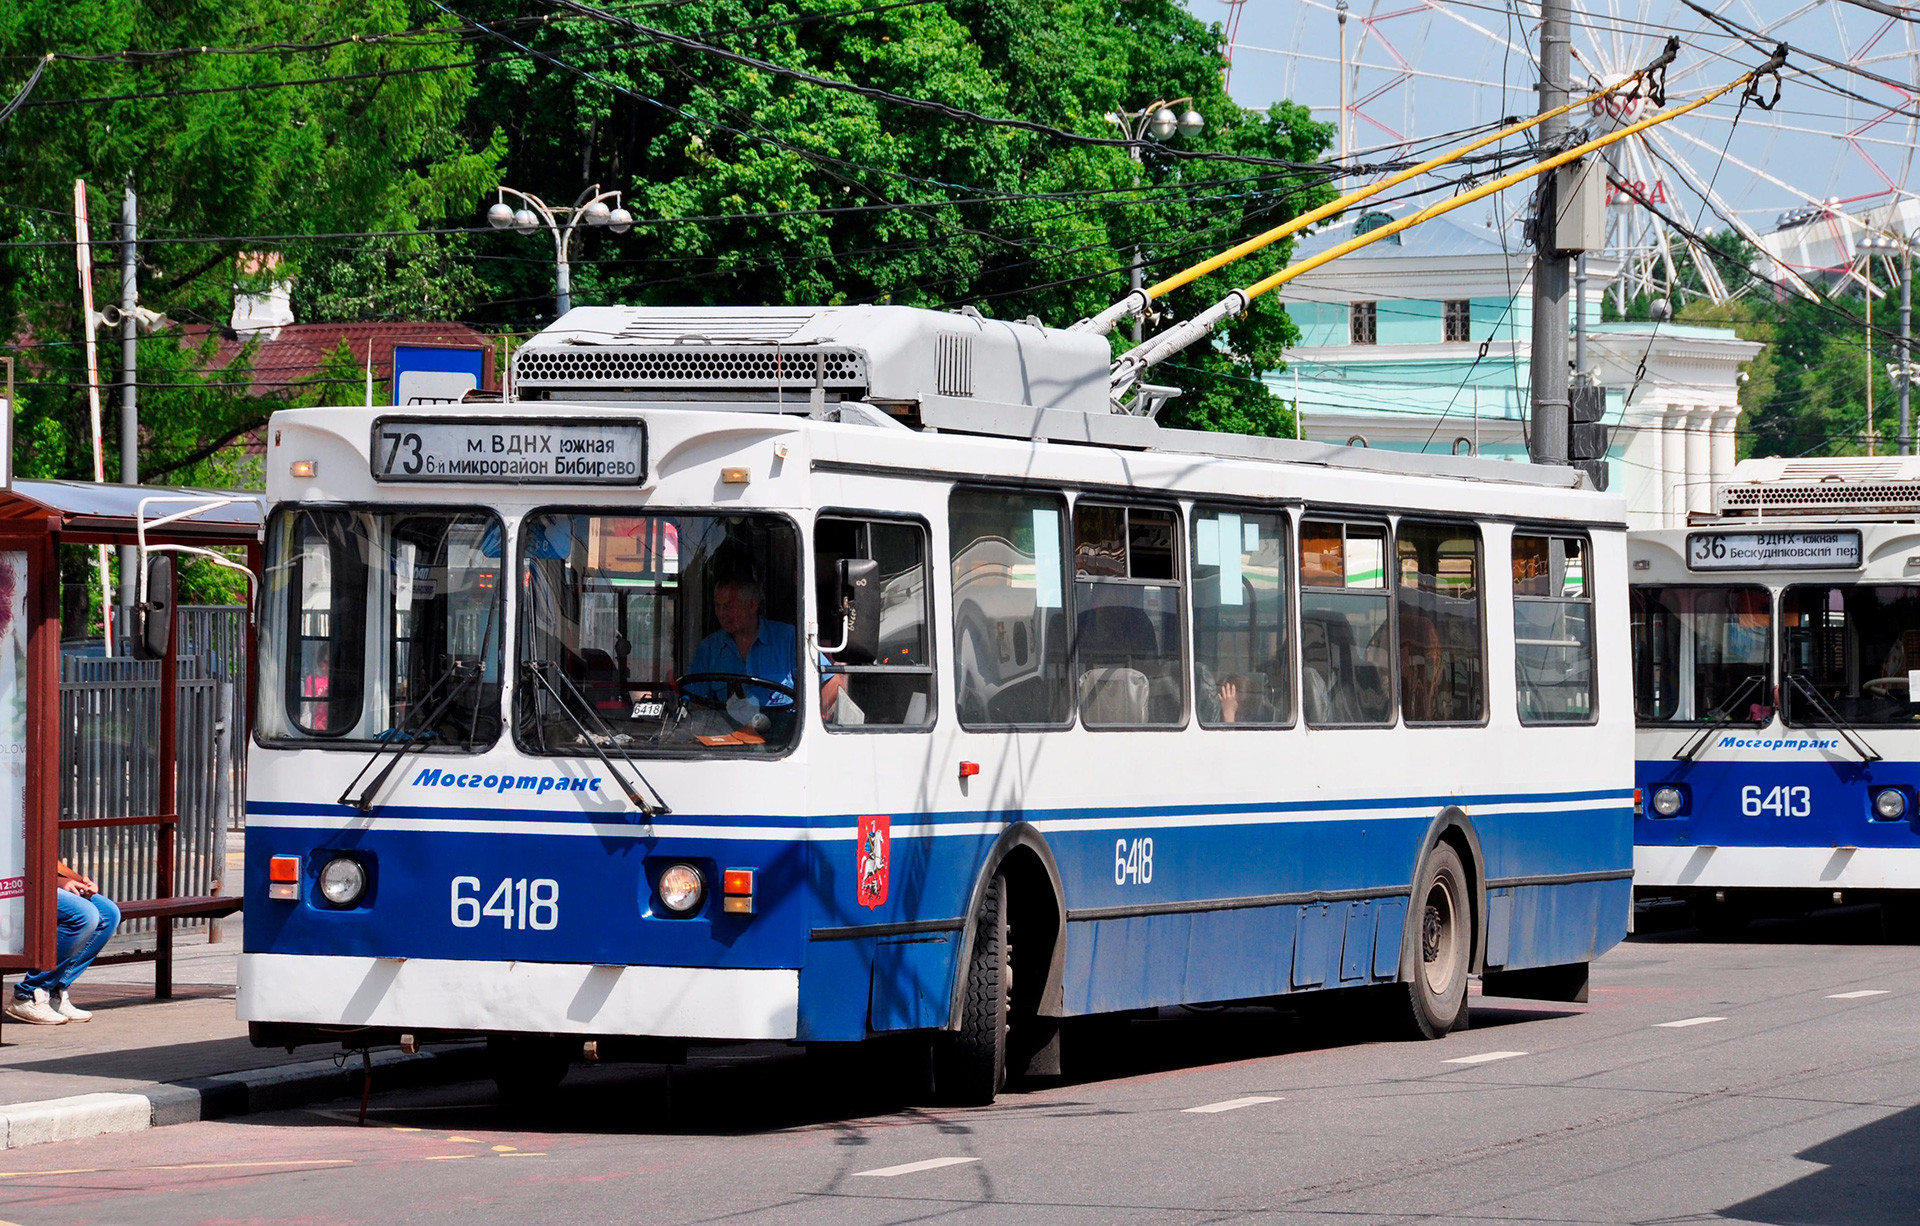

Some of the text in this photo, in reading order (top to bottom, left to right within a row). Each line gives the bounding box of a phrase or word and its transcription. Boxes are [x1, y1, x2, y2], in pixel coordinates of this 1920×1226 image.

[383, 433, 424, 475] 73
[467, 434, 615, 455] м. ВДНХ южная
[449, 457, 549, 476] микрорайон
[555, 456, 636, 477] Бибирево
[1695, 535, 1726, 560] 36
[1730, 547, 1831, 560] Бескудниковский
[634, 705, 660, 715] 6418
[1718, 737, 1839, 751] Мосгортранс
[412, 769, 602, 795] Мосгортранс
[1742, 785, 1811, 817] 6413
[1115, 837, 1153, 886] 6418
[451, 876, 559, 931] 6418
